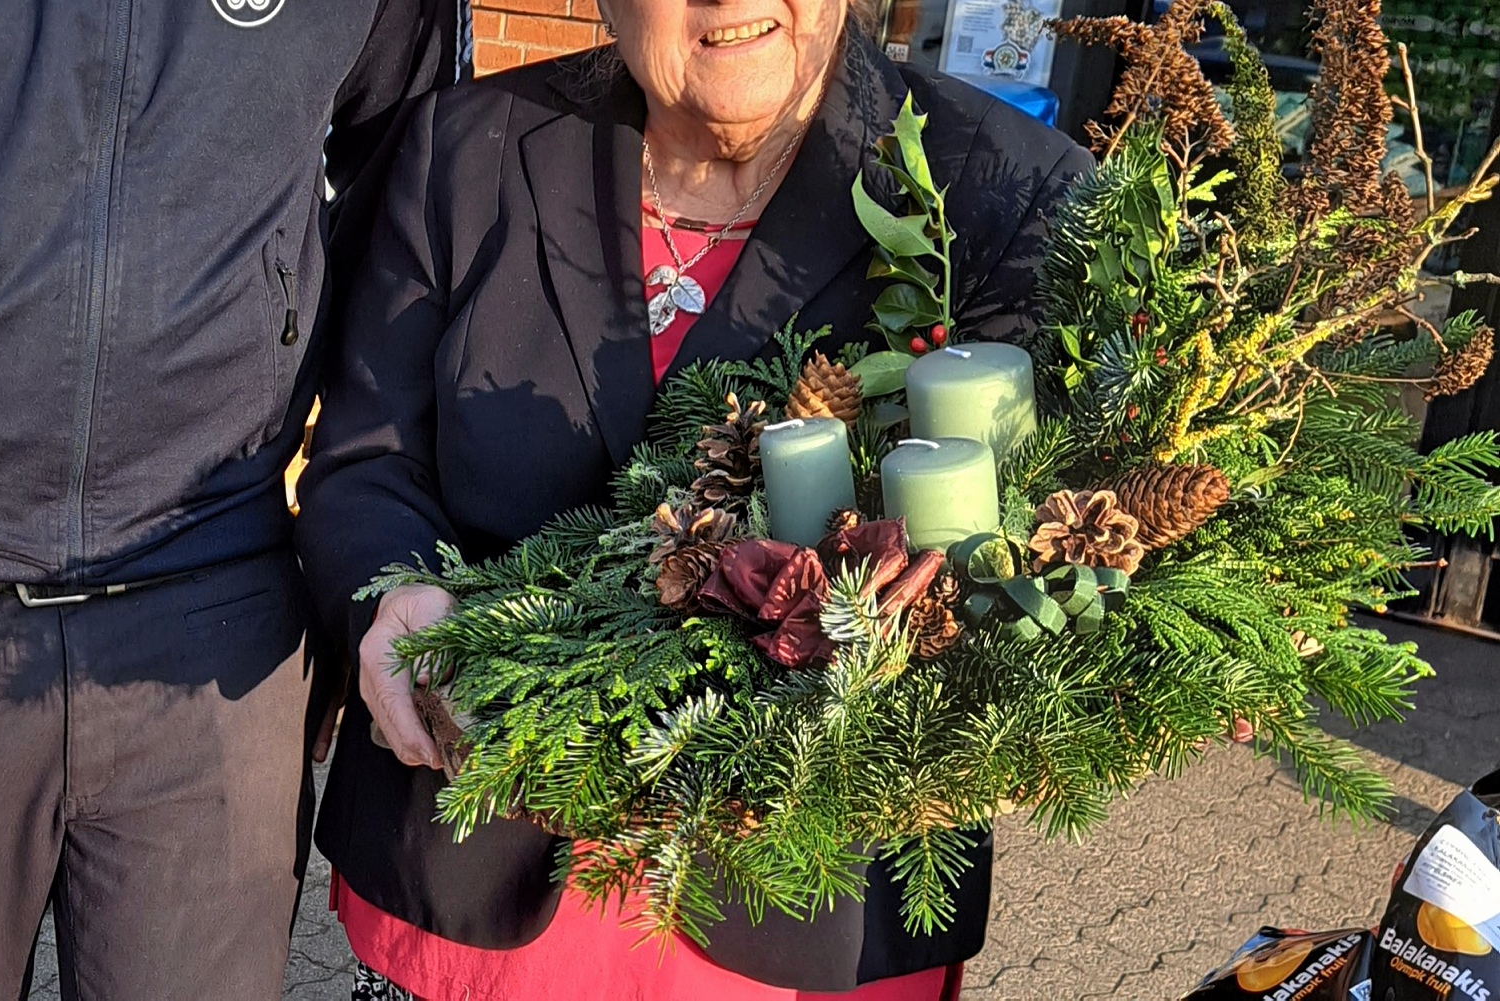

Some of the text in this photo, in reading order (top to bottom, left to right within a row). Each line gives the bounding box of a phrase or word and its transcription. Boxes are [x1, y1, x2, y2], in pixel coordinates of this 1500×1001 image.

[1321, 957, 1348, 977] fruit
[1379, 927, 1491, 1001] Balakanakis
[1390, 956, 1452, 995] Olympic fruit
